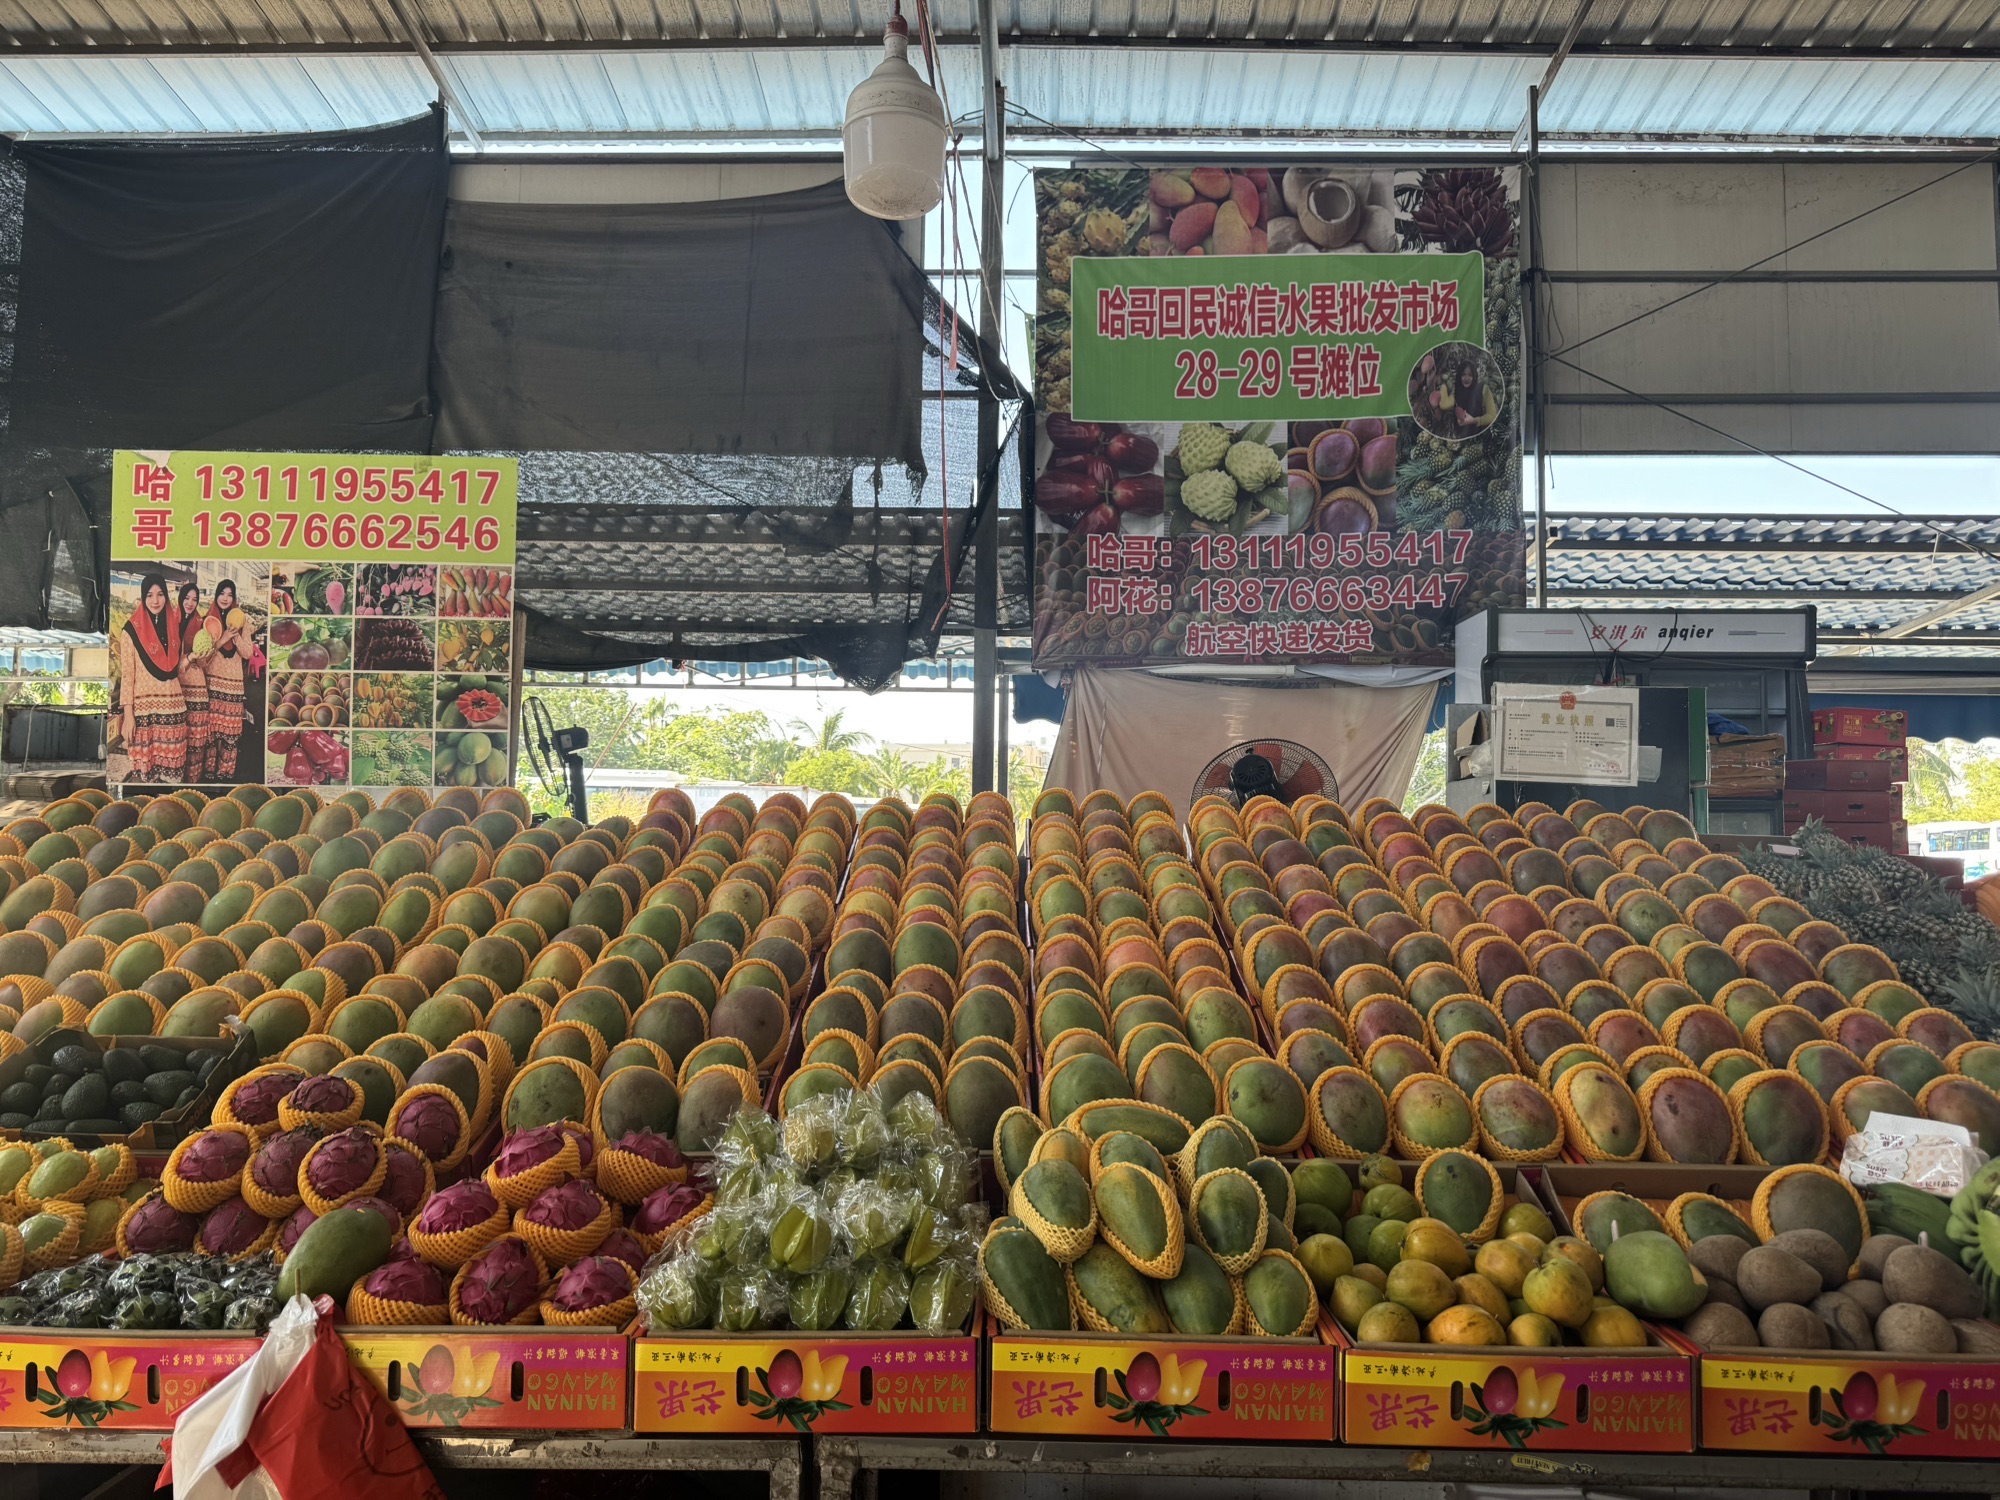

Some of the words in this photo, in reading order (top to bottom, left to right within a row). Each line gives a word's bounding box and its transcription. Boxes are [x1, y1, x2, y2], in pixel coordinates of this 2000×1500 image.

[1097, 280, 1460, 340] 哈哥回民诚信水果批发市场
[195, 465, 500, 505] 13111955417
[192, 512, 500, 552] 13876662546
[1191, 529, 1473, 570] 13111955417
[1191, 573, 1469, 614] 13876663447
[1185, 621, 1373, 657] 航空快递发货
[1658, 625, 1714, 640] anqier
[1541, 713, 1594, 726] 营业执照
[526, 1372, 621, 1392] MANGO
[877, 1373, 972, 1394] MANGO
[1234, 1382, 1329, 1403] MANGO
[527, 1394, 617, 1411] HAINAN
[654, 1380, 725, 1418] 芒果
[877, 1396, 967, 1414] HAINAN
[1011, 1380, 1083, 1419] 芒果
[1235, 1403, 1325, 1421] HAINAN
[1366, 1392, 1439, 1431] 芒果
[1592, 1393, 1687, 1414] MANGO
[1593, 1415, 1684, 1433] HAINAN
[1724, 1397, 1798, 1435] 芒果
